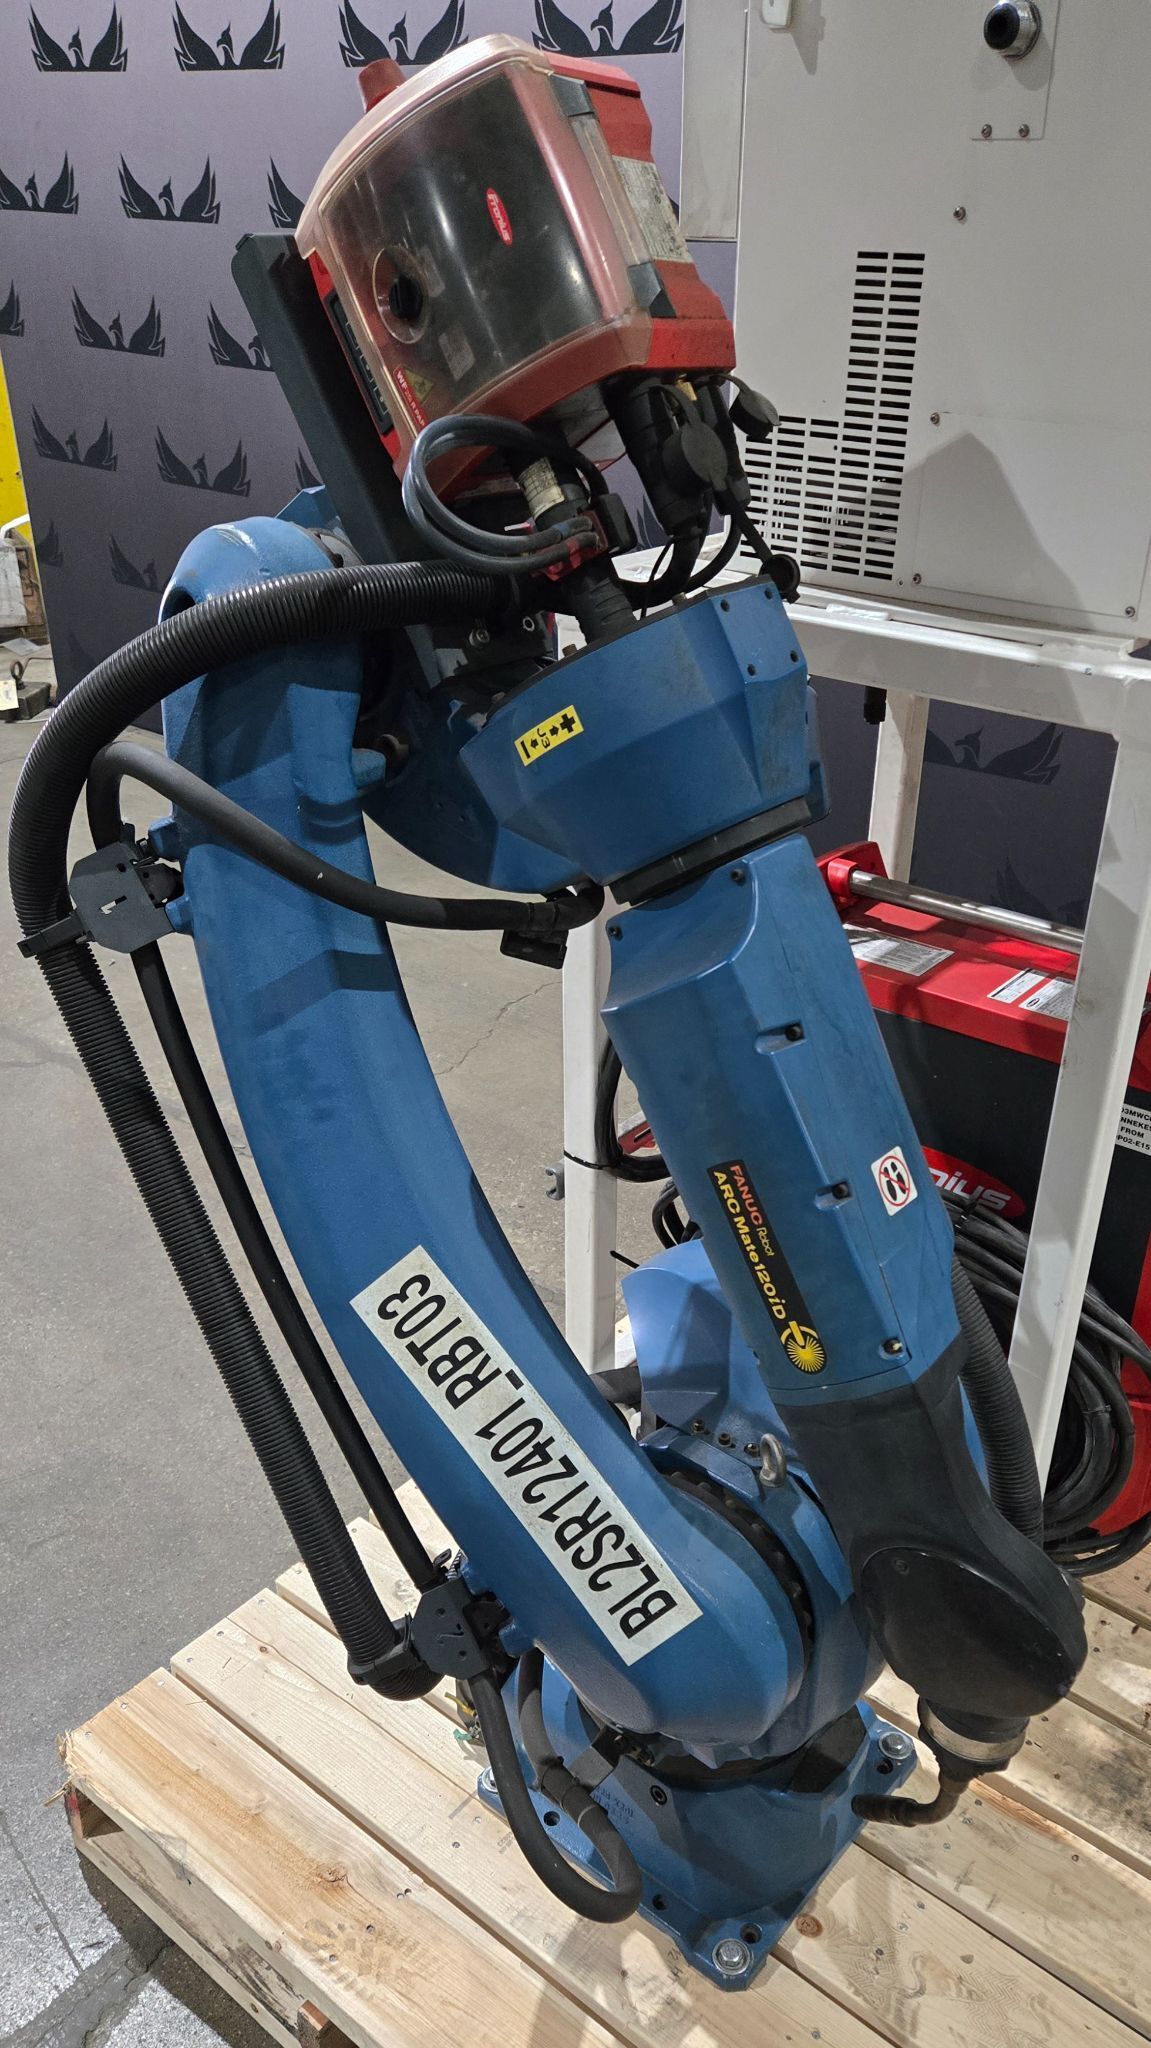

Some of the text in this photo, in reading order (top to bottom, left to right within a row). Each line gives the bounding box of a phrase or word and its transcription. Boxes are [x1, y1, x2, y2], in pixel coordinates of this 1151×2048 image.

[487, 193, 511, 241] Fronius
[397, 370, 408, 390] WF
[536, 727, 551, 749] J3
[1116, 1134, 1150, 1150] P02-E15
[1120, 1126, 1145, 1138] FROM
[713, 1171, 741, 1213] ARC
[928, 1167, 1011, 1210] nius
[730, 1164, 775, 1257] FANUC Robot
[377, 1273, 678, 1640] BL2SR12401_RBT03
